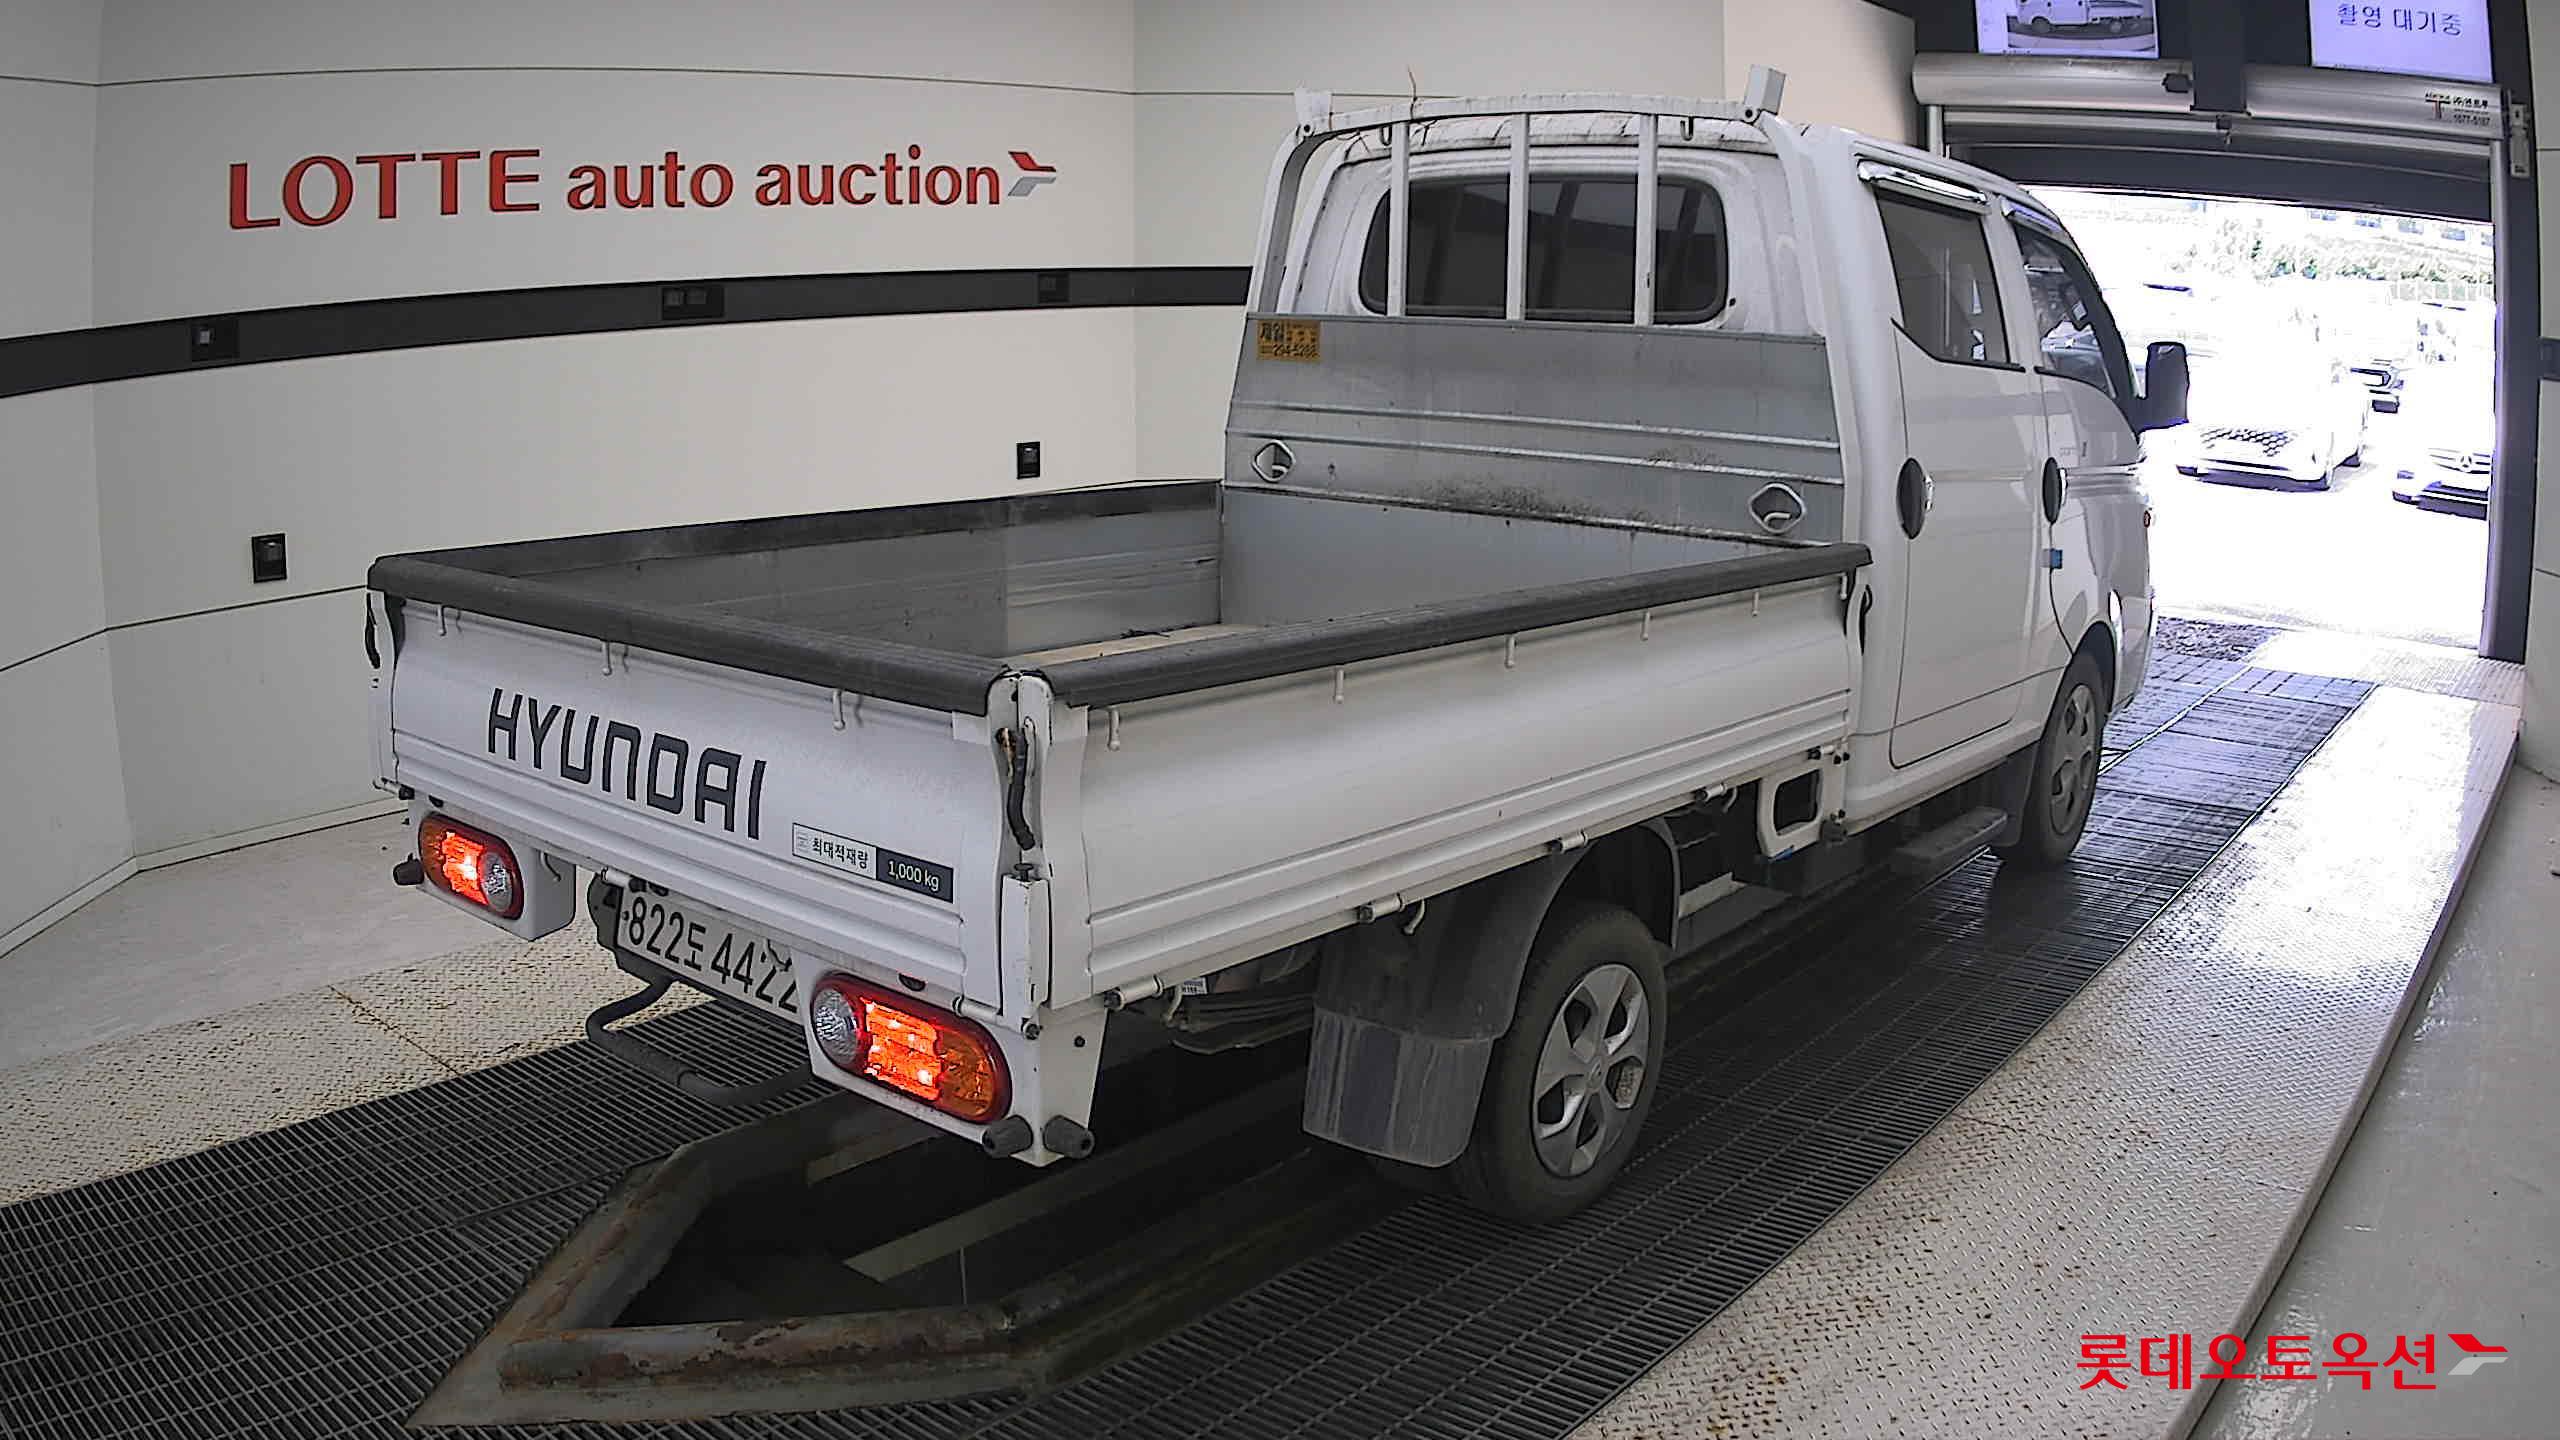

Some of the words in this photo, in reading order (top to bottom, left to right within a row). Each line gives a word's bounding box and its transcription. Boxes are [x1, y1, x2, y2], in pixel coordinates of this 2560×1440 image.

[2337, 4, 2382, 29] 촬영
[2393, 8, 2463, 36] 대기중
[229, 149, 541, 231] LOTTE
[566, 151, 734, 210] auto
[755, 144, 1001, 207] auction
[488, 687, 767, 841] HYUNDAI
[812, 838, 869, 870] 최대적재량
[888, 860, 922, 884] 1,000
[924, 868, 940, 892] kg
[629, 896, 707, 972] 822도
